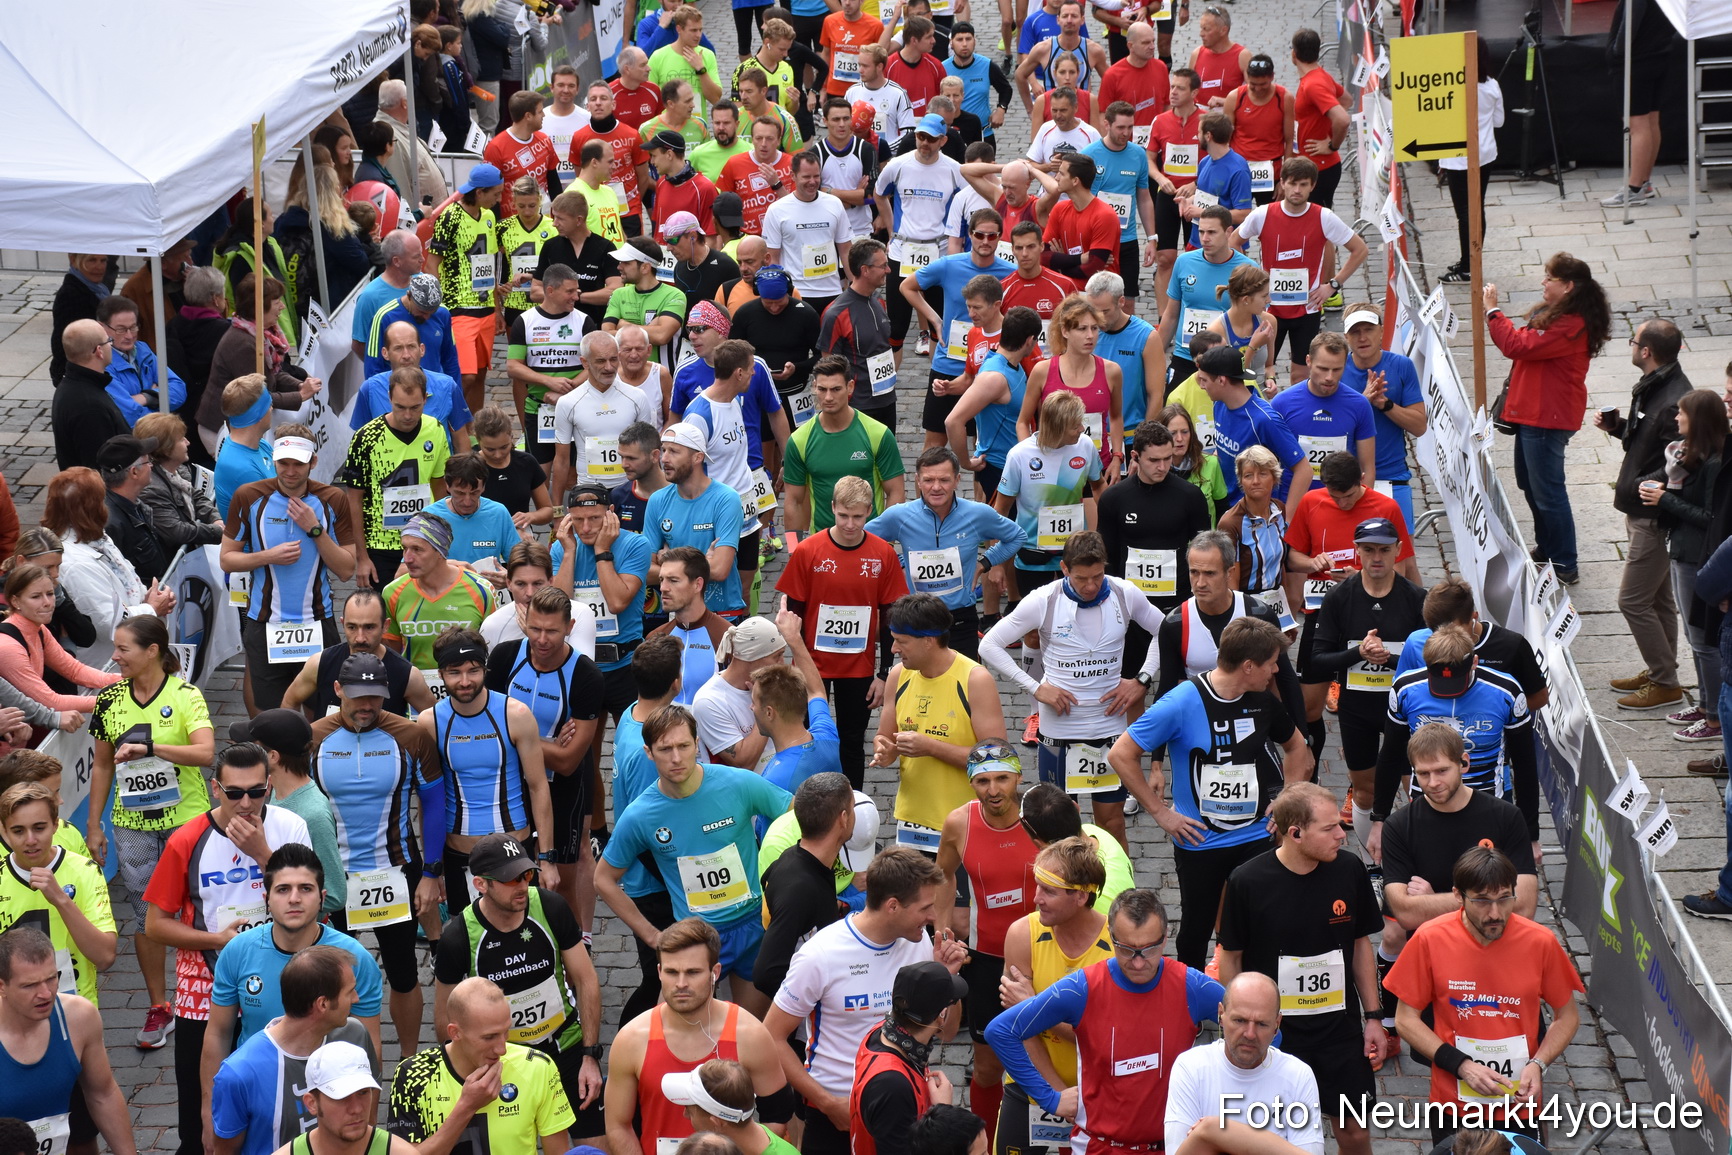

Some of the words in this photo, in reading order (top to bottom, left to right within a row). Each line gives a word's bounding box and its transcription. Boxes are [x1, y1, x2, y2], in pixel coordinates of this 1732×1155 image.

[330, 50, 363, 93] PARTL
[358, 22, 397, 71] Neumarkt
[837, 60, 857, 72] 2133
[1394, 67, 1466, 92] Jugend
[1417, 91, 1454, 112] lauf
[1171, 153, 1190, 165] 402
[814, 255, 827, 266] 60
[910, 254, 930, 266] 149
[475, 265, 492, 278] 2669
[1273, 279, 1303, 292] 2092
[1422, 300, 1437, 317] swn
[1188, 321, 1208, 333] 215
[1446, 312, 1454, 333] swn
[530, 348, 578, 358] Laufteam
[540, 356, 568, 366] Fürth
[874, 362, 894, 381] 2999
[543, 415, 555, 428] 27
[1312, 415, 1333, 423] skinfit
[600, 450, 618, 463] 16
[850, 450, 867, 459] AOK
[391, 498, 424, 515] 2690
[693, 523, 714, 531] BOCK
[1049, 518, 1073, 534] 181
[473, 540, 496, 548] BOCK
[917, 562, 955, 581] 2024
[1137, 564, 1163, 579] 151
[927, 581, 949, 590] Michael
[1537, 577, 1550, 606] swn
[399, 620, 472, 637] BOCK
[824, 620, 860, 636] 2301
[1555, 614, 1574, 640] swn
[275, 628, 314, 645] 2707
[282, 647, 310, 655] Sebastian
[1058, 656, 1118, 669] IronTrizone.de
[1073, 668, 1109, 679] ULMER
[1078, 757, 1107, 775] 218
[124, 772, 169, 793] 2686
[1087, 778, 1099, 787] Ingo
[1209, 780, 1250, 800] 2541
[139, 794, 161, 803] Andrea
[1619, 787, 1633, 811] sw
[1215, 803, 1244, 813] Wolfgang
[702, 816, 735, 833] BOCK
[913, 834, 930, 842] Alfred
[1647, 818, 1672, 847] swn
[696, 867, 732, 889] 109
[359, 885, 394, 907] 276
[709, 891, 727, 900] Toms
[995, 894, 1013, 905] DEHN
[368, 910, 389, 918] Volker
[504, 952, 527, 967] DAV
[487, 958, 550, 982] Röthenbach
[849, 962, 870, 971] Wolfgang
[1296, 972, 1331, 993] 136
[1297, 996, 1328, 1005] Christian
[1497, 995, 1521, 1006] 2006
[511, 1001, 548, 1028] 257
[519, 1023, 550, 1038] Christian
[1126, 1060, 1147, 1070] DEHN
[498, 1103, 520, 1114] Partl
